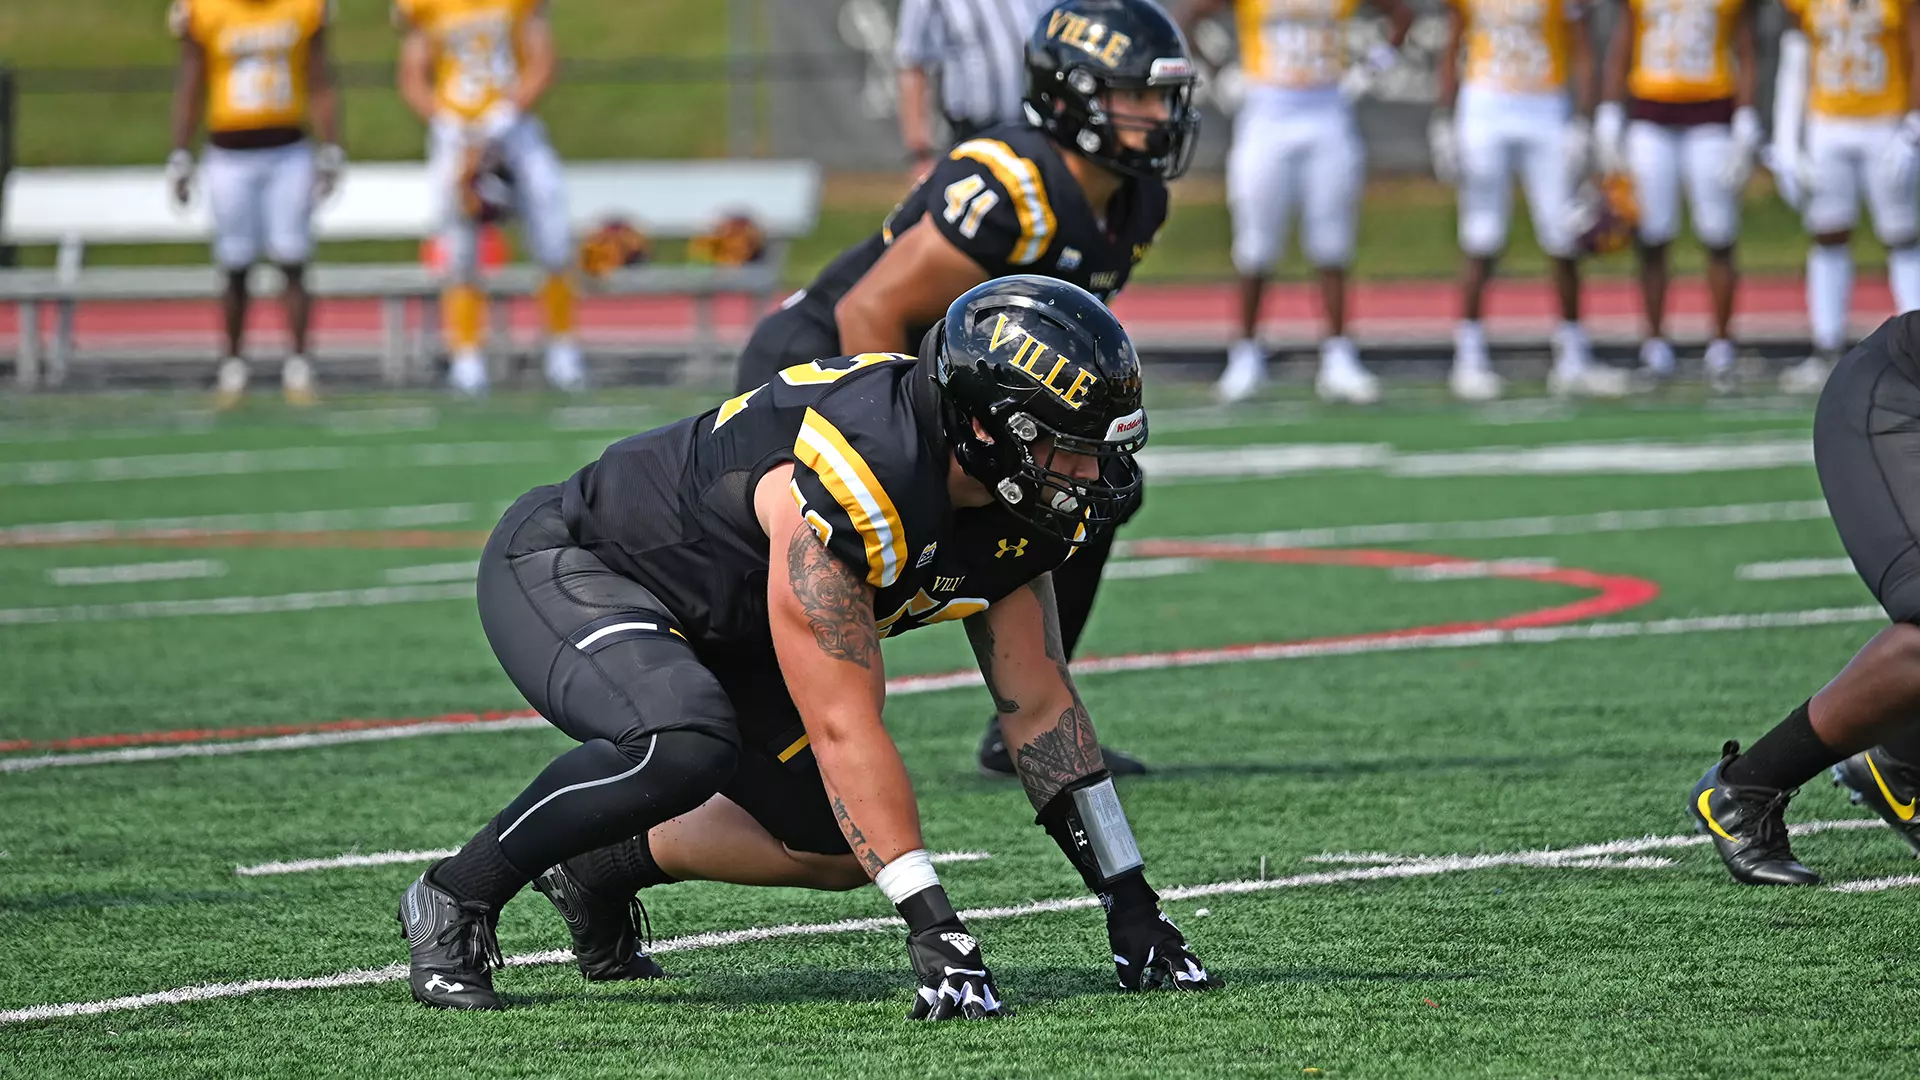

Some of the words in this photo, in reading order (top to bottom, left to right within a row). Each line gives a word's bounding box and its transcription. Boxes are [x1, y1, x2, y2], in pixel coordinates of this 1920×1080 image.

[1046, 8, 1132, 69] VILLE
[943, 173, 1000, 240] 41
[988, 312, 1098, 411] VILLE
